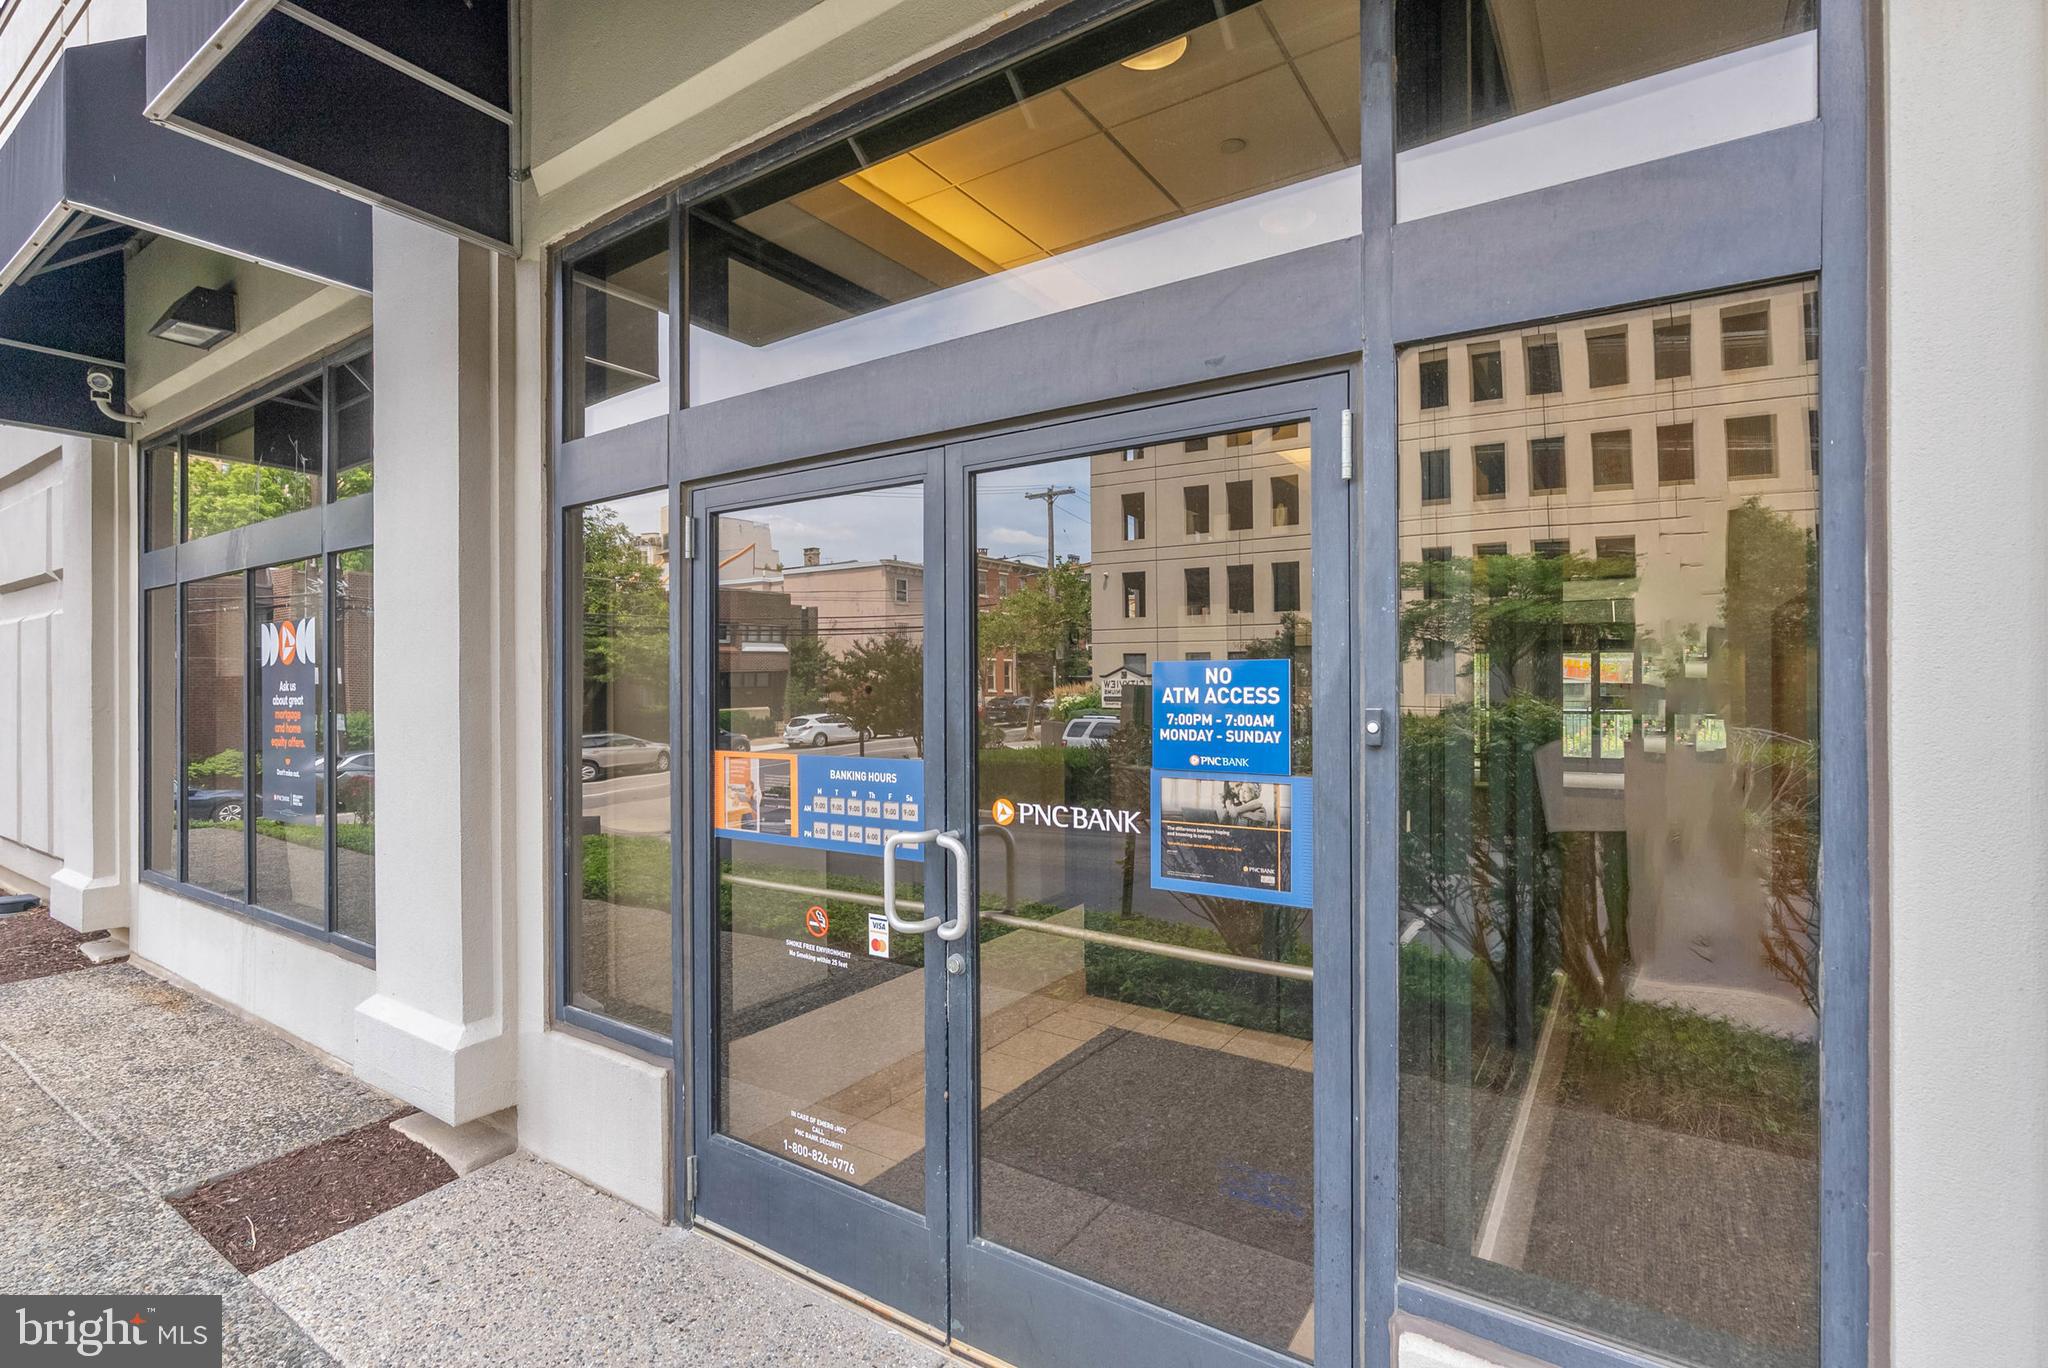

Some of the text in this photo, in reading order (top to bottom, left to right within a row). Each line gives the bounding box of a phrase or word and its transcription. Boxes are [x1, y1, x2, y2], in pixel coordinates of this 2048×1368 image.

[1205, 667, 1232, 685] NO
[279, 680, 297, 692] Ask us
[272, 694, 304, 708] about great
[1161, 687, 1281, 705] ATM ACCESS
[1166, 713, 1213, 726] 7:00PM
[1225, 714, 1275, 728] 7:00AM
[1159, 728, 1214, 742] MONDAY
[1225, 730, 1282, 744] SUNDAY
[829, 770, 898, 784] BANKING HOURS
[851, 790, 858, 798] W
[868, 791, 876, 800] Th
[888, 793, 893, 801] F
[905, 794, 913, 803] Sa
[803, 804, 812, 812] AM
[814, 800, 826, 809] 9:00
[848, 804, 860, 812] 9:00
[866, 805, 878, 815] 9:00
[884, 807, 897, 816] 9:00
[903, 808, 916, 818] 9:00
[803, 830, 812, 838] PM
[872, 921, 886, 930] VISA
[786, 939, 852, 959] SMOKE FREE ENVIRONMENT
[796, 951, 816, 962] Smoking
[816, 956, 832, 964] within
[838, 960, 849, 969] feet
[797, 1112, 809, 1122] CASE
[810, 1116, 817, 1124] OF
[812, 1126, 825, 1136] CALL
[794, 1128, 843, 1151] PNC BANK SECURITY
[783, 1139, 856, 1175] 1-800-826-6776
